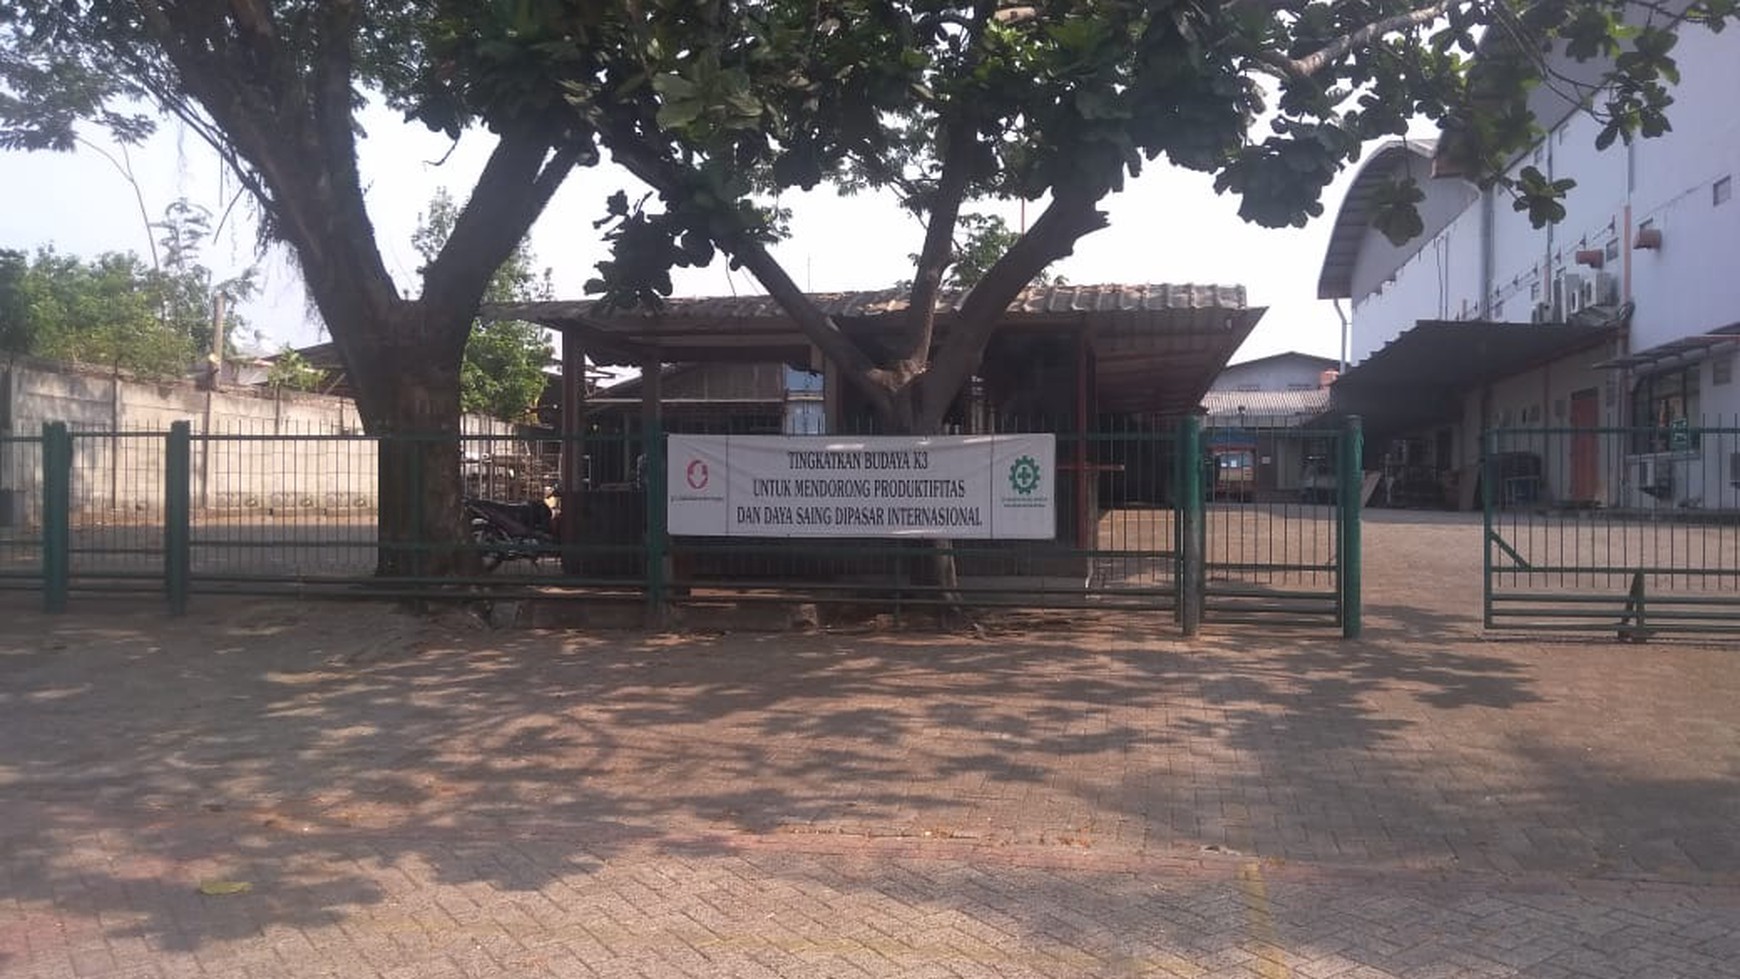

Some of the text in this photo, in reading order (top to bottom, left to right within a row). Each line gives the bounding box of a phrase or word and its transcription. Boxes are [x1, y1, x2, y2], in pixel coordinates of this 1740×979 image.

[788, 451, 928, 470] TINGKATKAN BUDAYA K3
[753, 479, 965, 498] UNTUK MENDORONG PRODUKTIFITAS
[737, 506, 983, 526] DAN DAYA SAING DIPASAR INTERNASIONAL
